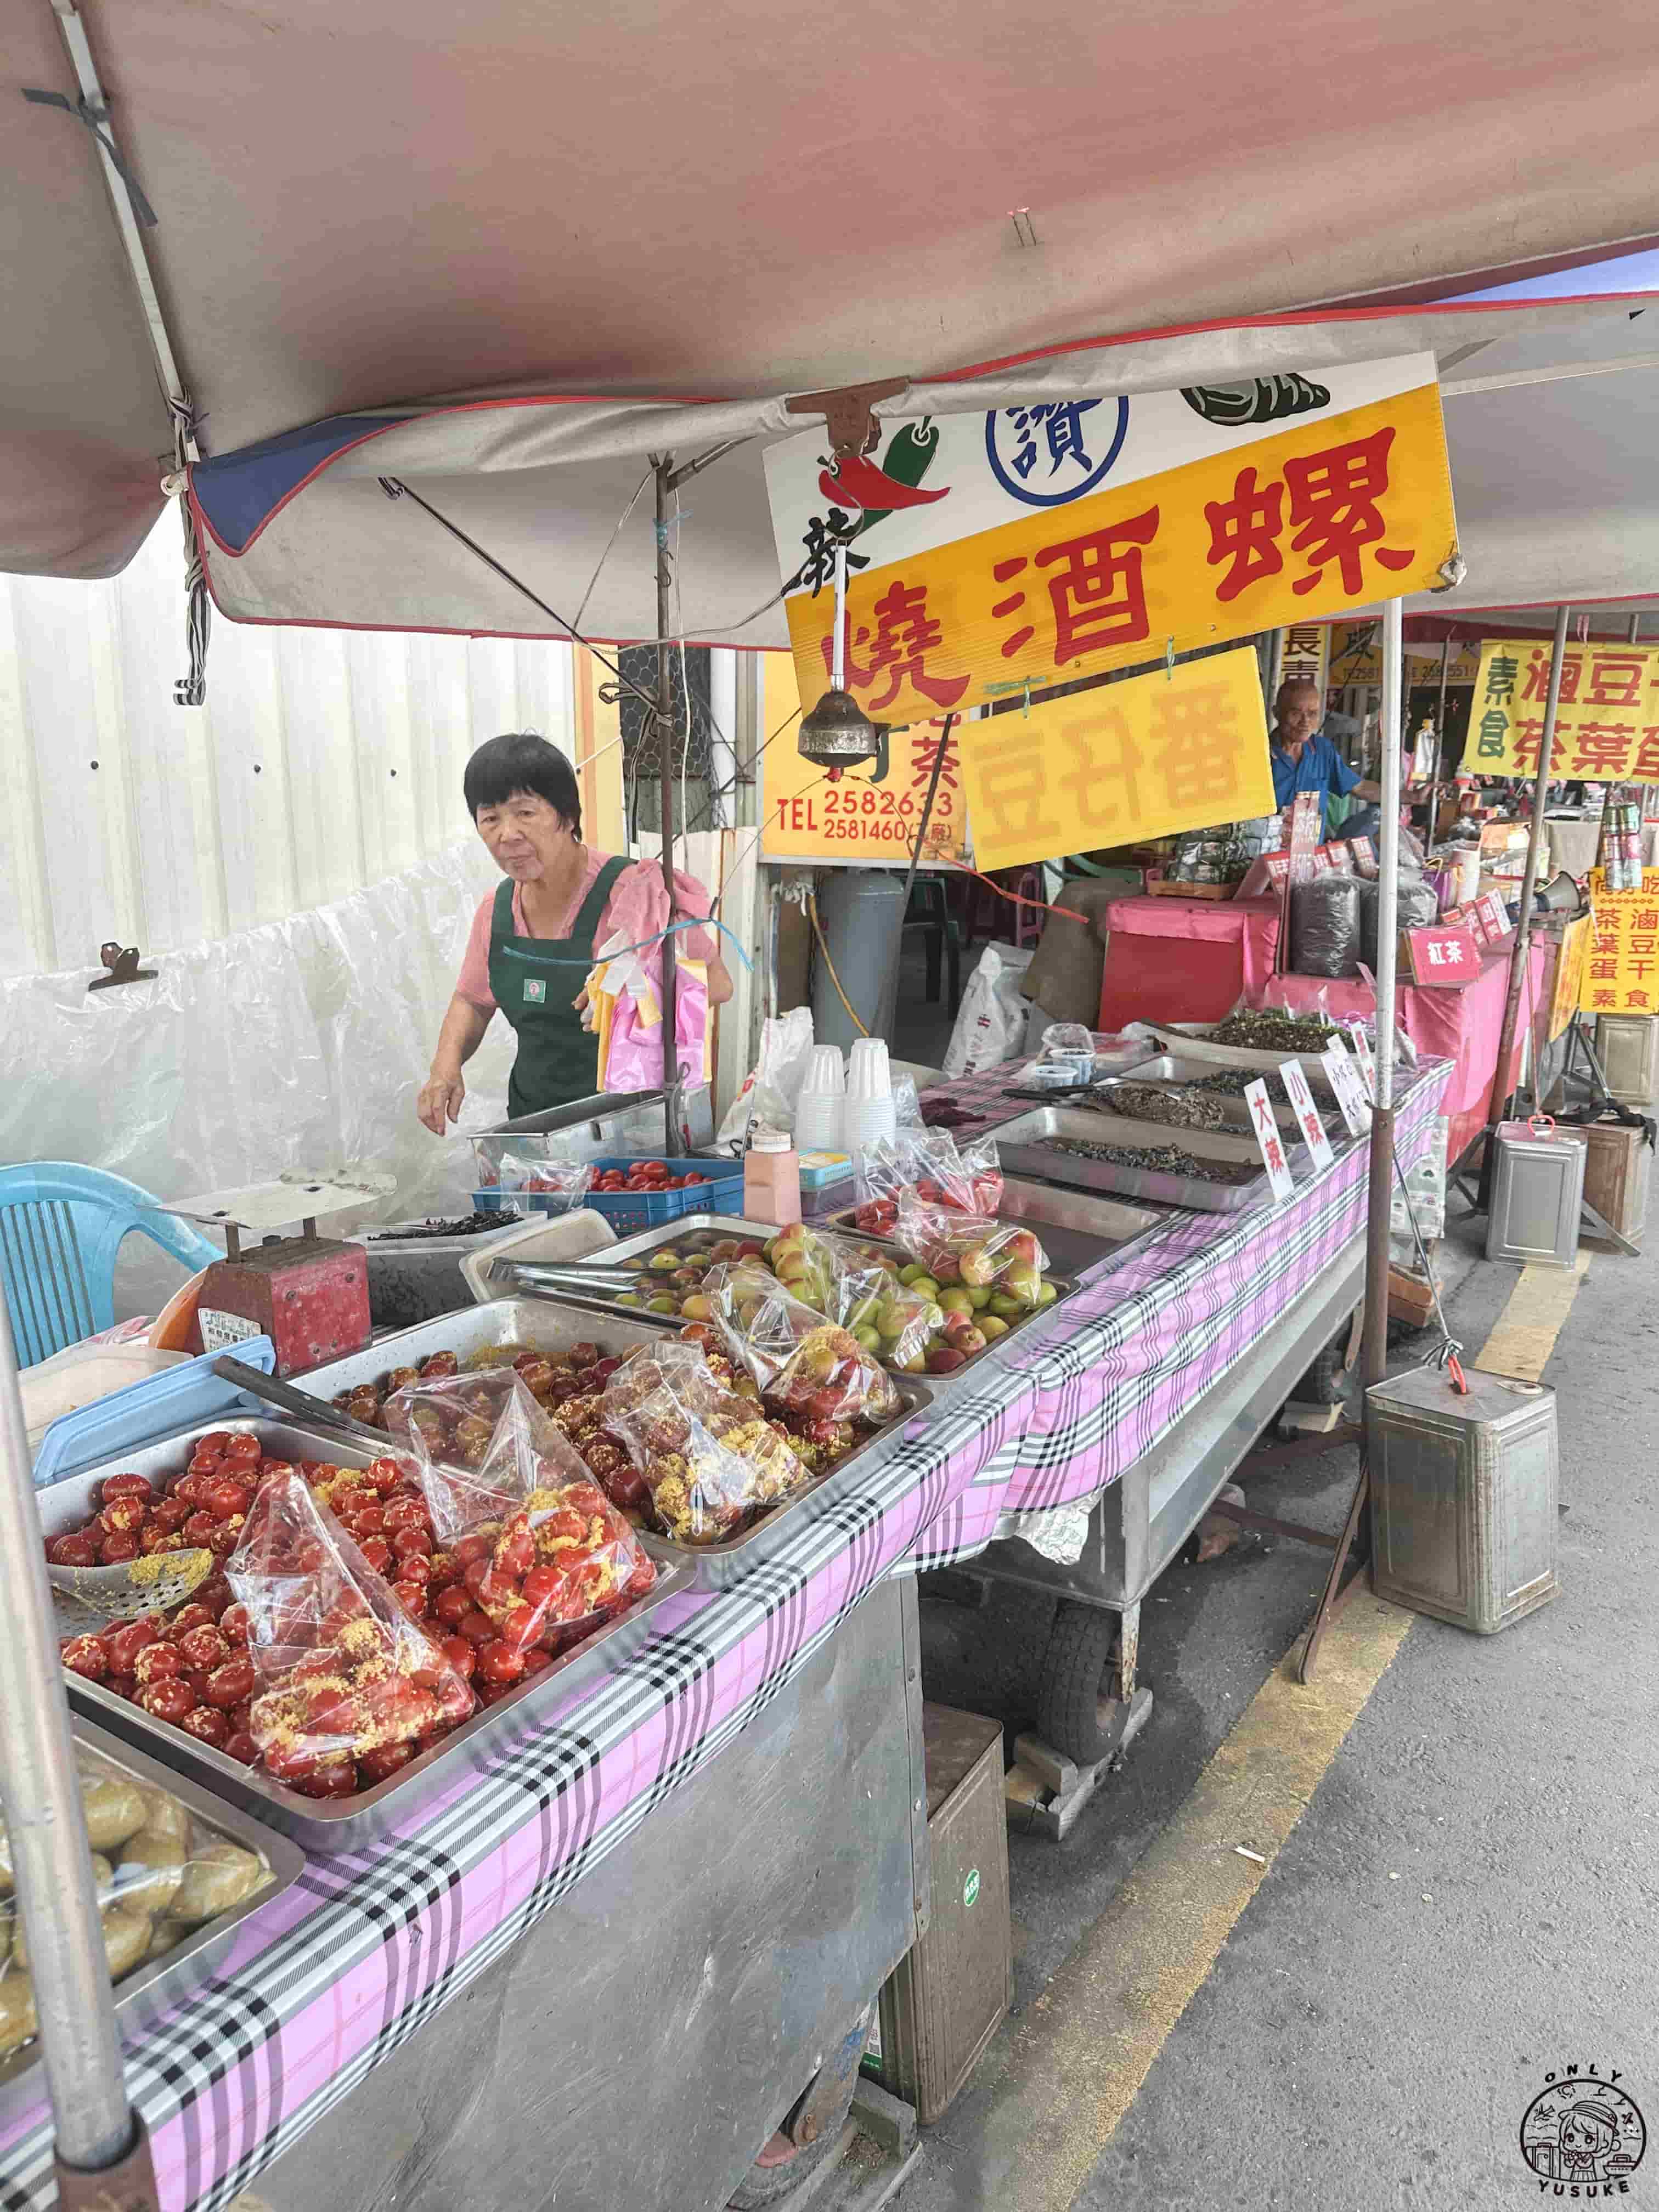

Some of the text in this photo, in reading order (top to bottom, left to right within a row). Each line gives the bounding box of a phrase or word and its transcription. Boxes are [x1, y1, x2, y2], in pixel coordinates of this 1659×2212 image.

[821, 427, 1415, 712] 燒酒螺
[1520, 649, 1659, 707] 滷豆
[1477, 657, 1519, 758] 素食
[777, 798, 817, 831] TEL
[1427, 940, 1464, 966] 紅茶
[1589, 909, 1622, 979] 茶葉蛋
[1593, 989, 1650, 1008] 素食
